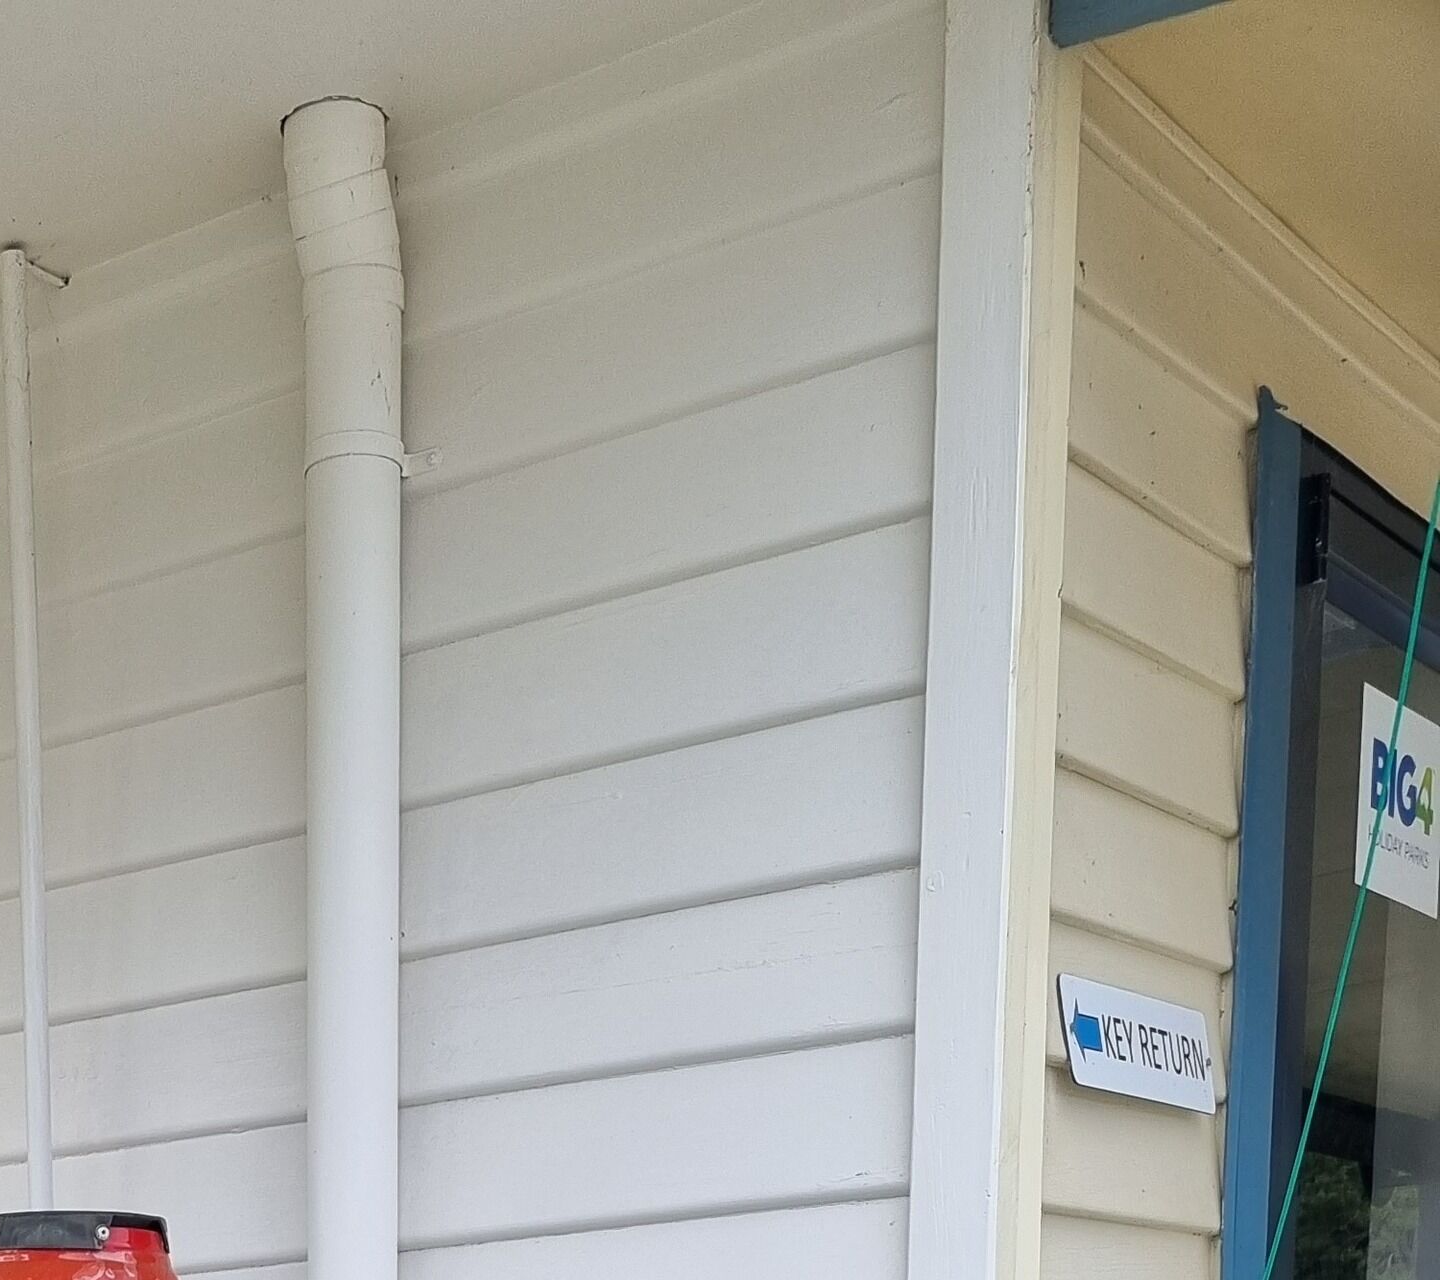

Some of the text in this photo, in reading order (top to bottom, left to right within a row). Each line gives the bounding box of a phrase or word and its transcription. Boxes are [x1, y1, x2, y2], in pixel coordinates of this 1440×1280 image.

[1371, 737, 1433, 835] BIG4
[1102, 1014, 1205, 1081] KEY RETURN
